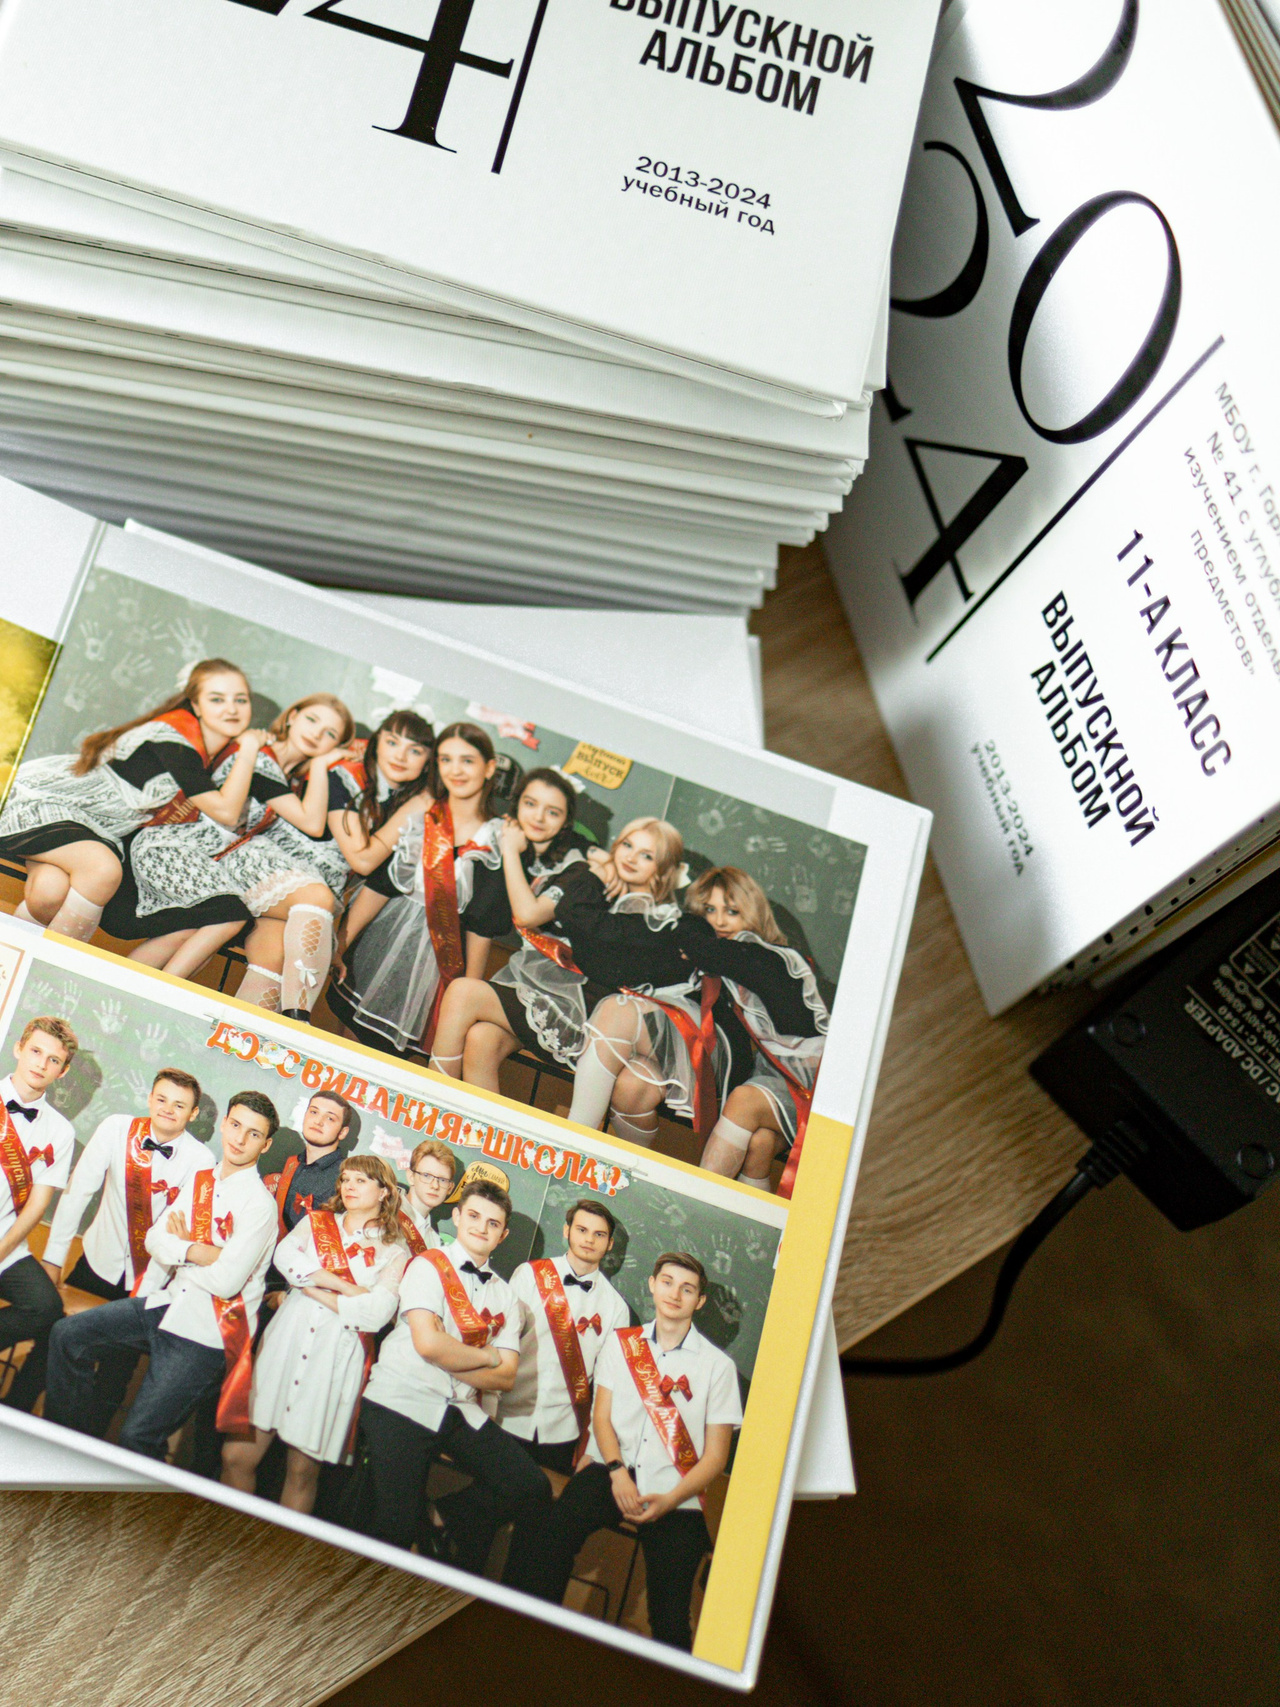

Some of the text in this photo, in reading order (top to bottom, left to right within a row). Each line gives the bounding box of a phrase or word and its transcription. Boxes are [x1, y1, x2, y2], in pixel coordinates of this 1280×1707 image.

[638, 29, 822, 116] АЛЬБОМ
[621, 175, 776, 235] учебный год
[635, 156, 772, 210] 2013-2024
[1214, 381, 1255, 455] МБОУ
[1206, 430, 1225, 466] №
[1223, 470, 1243, 506] 41
[1184, 446, 1248, 586] изучением
[1116, 529, 1233, 777] 11-А КЛАСС
[1030, 660, 1113, 830] АЛЬБОМ
[1040, 590, 1160, 848] ВЫПУСКНОЙ
[984, 738, 1035, 857] 2013-2024
[206, 1021, 261, 1061] ДО
[1184, 997, 1246, 1059] ADAPTER
[1240, 1056, 1265, 1081] DC
